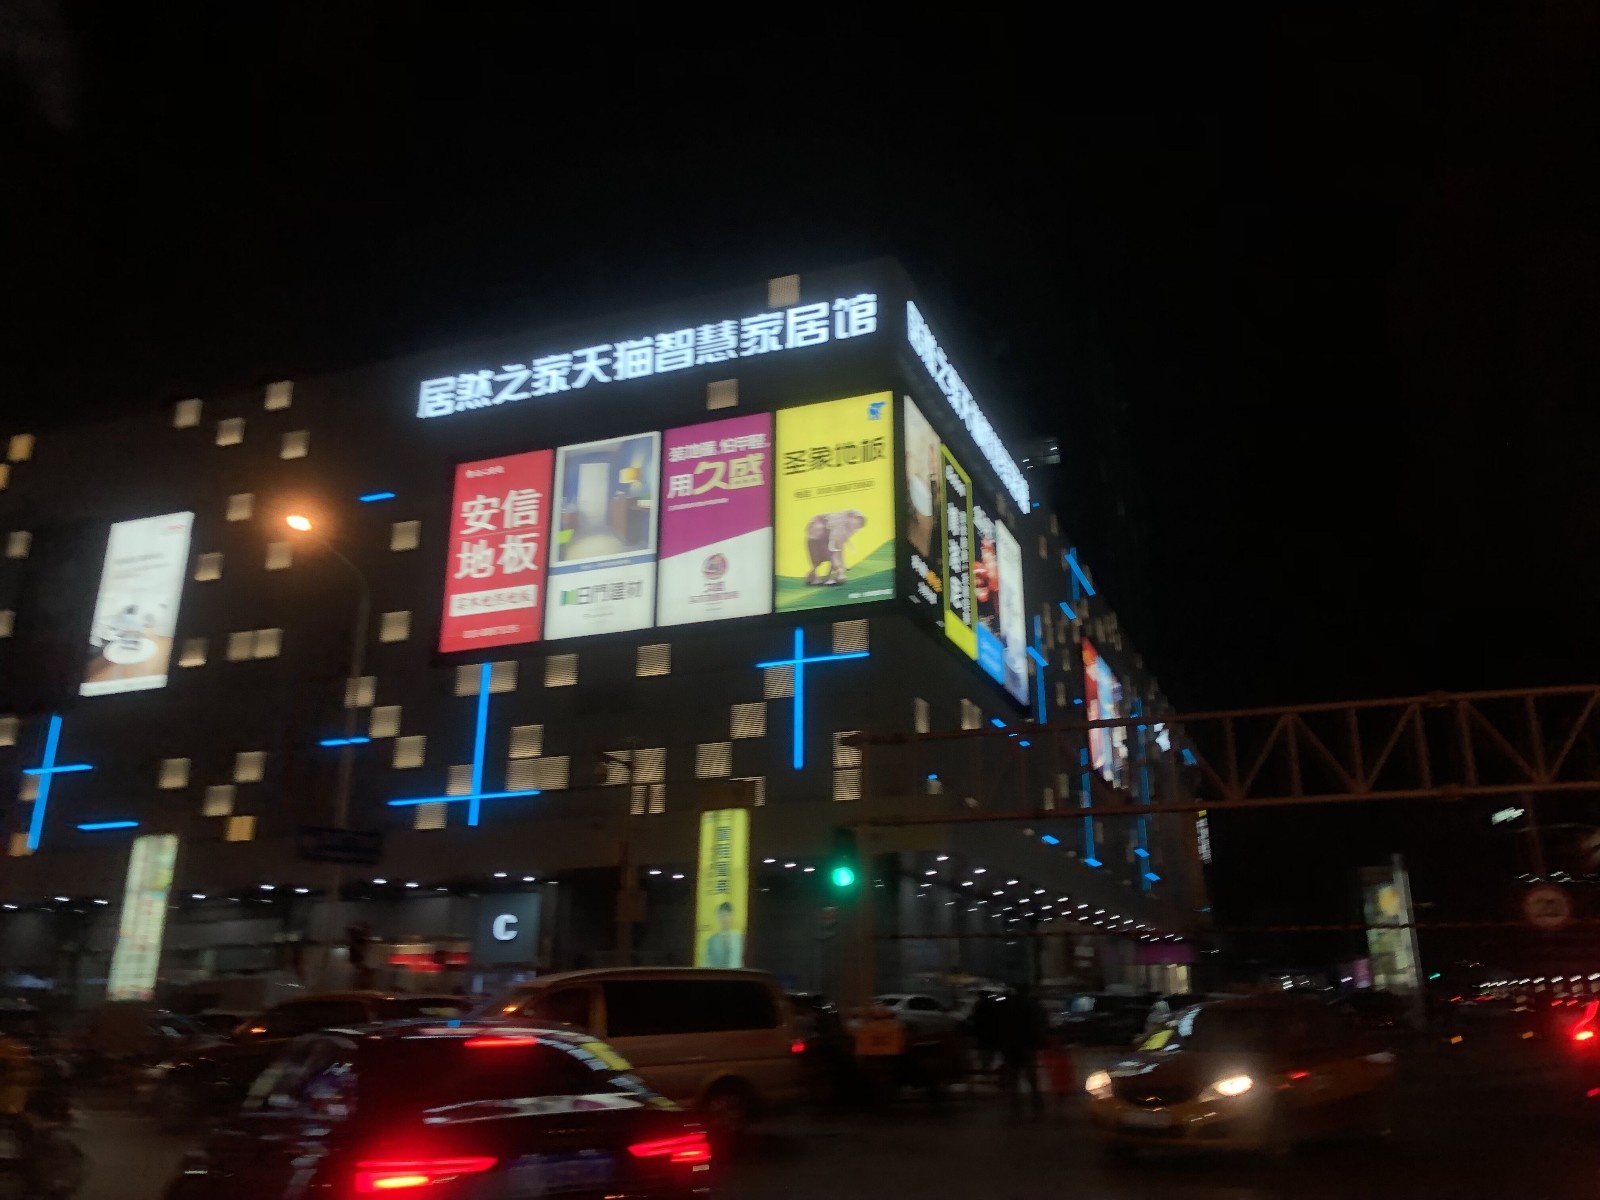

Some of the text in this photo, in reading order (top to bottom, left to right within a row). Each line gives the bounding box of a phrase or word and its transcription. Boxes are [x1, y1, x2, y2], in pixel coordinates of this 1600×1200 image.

[416, 293, 878, 419] 居然之家天猫智慧家居馆
[666, 452, 766, 499] 用久盛
[783, 436, 886, 476] 圣象地板
[459, 488, 544, 535] 安信
[453, 532, 540, 580] 地板
[492, 914, 519, 941] C
